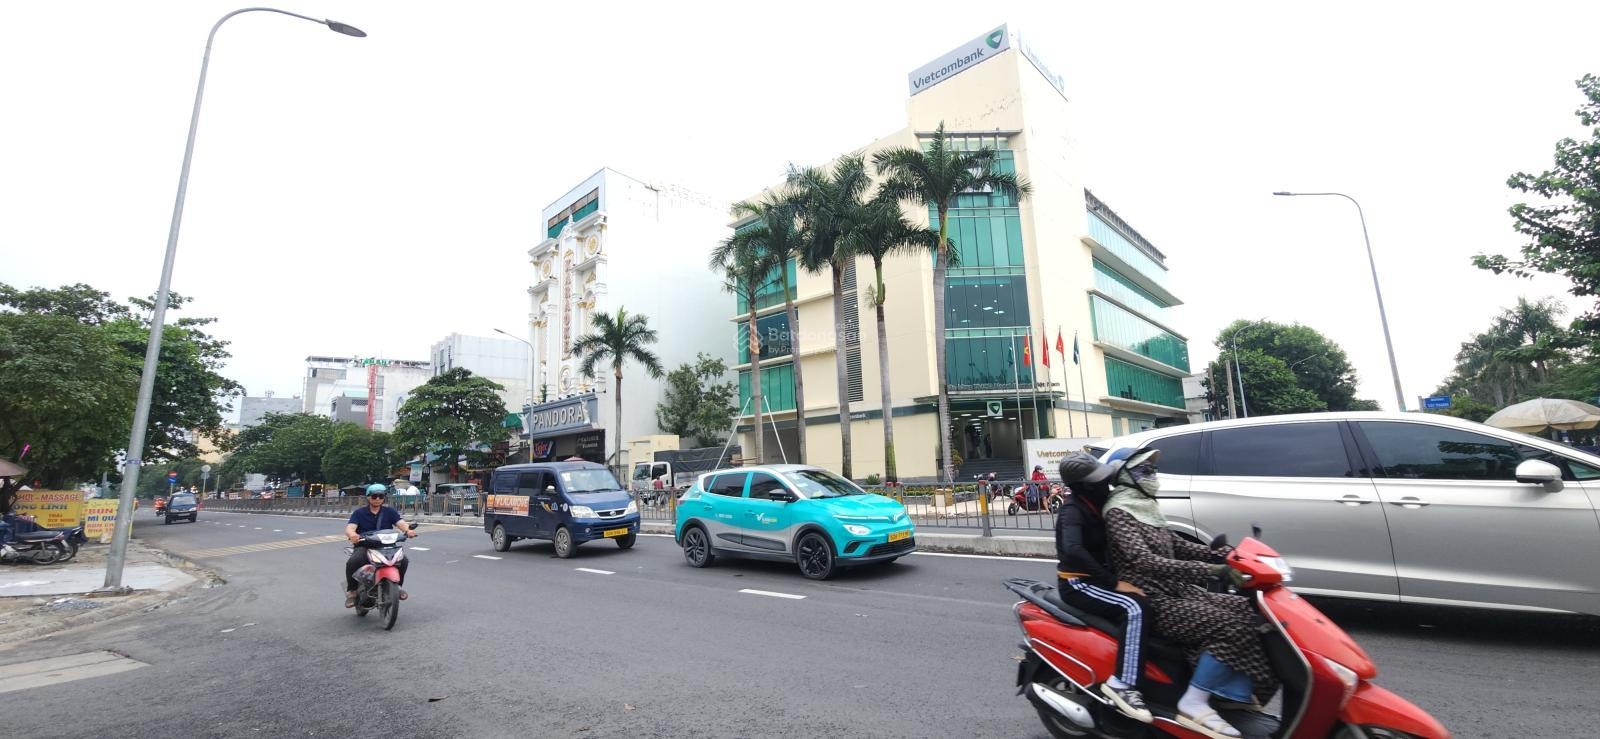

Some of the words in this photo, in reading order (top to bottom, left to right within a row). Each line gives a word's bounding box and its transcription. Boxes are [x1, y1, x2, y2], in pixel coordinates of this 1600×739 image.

[913, 47, 984, 89] Vietcombank
[533, 406, 585, 430] PANDORA
[41, 493, 80, 502] MASSAGE
